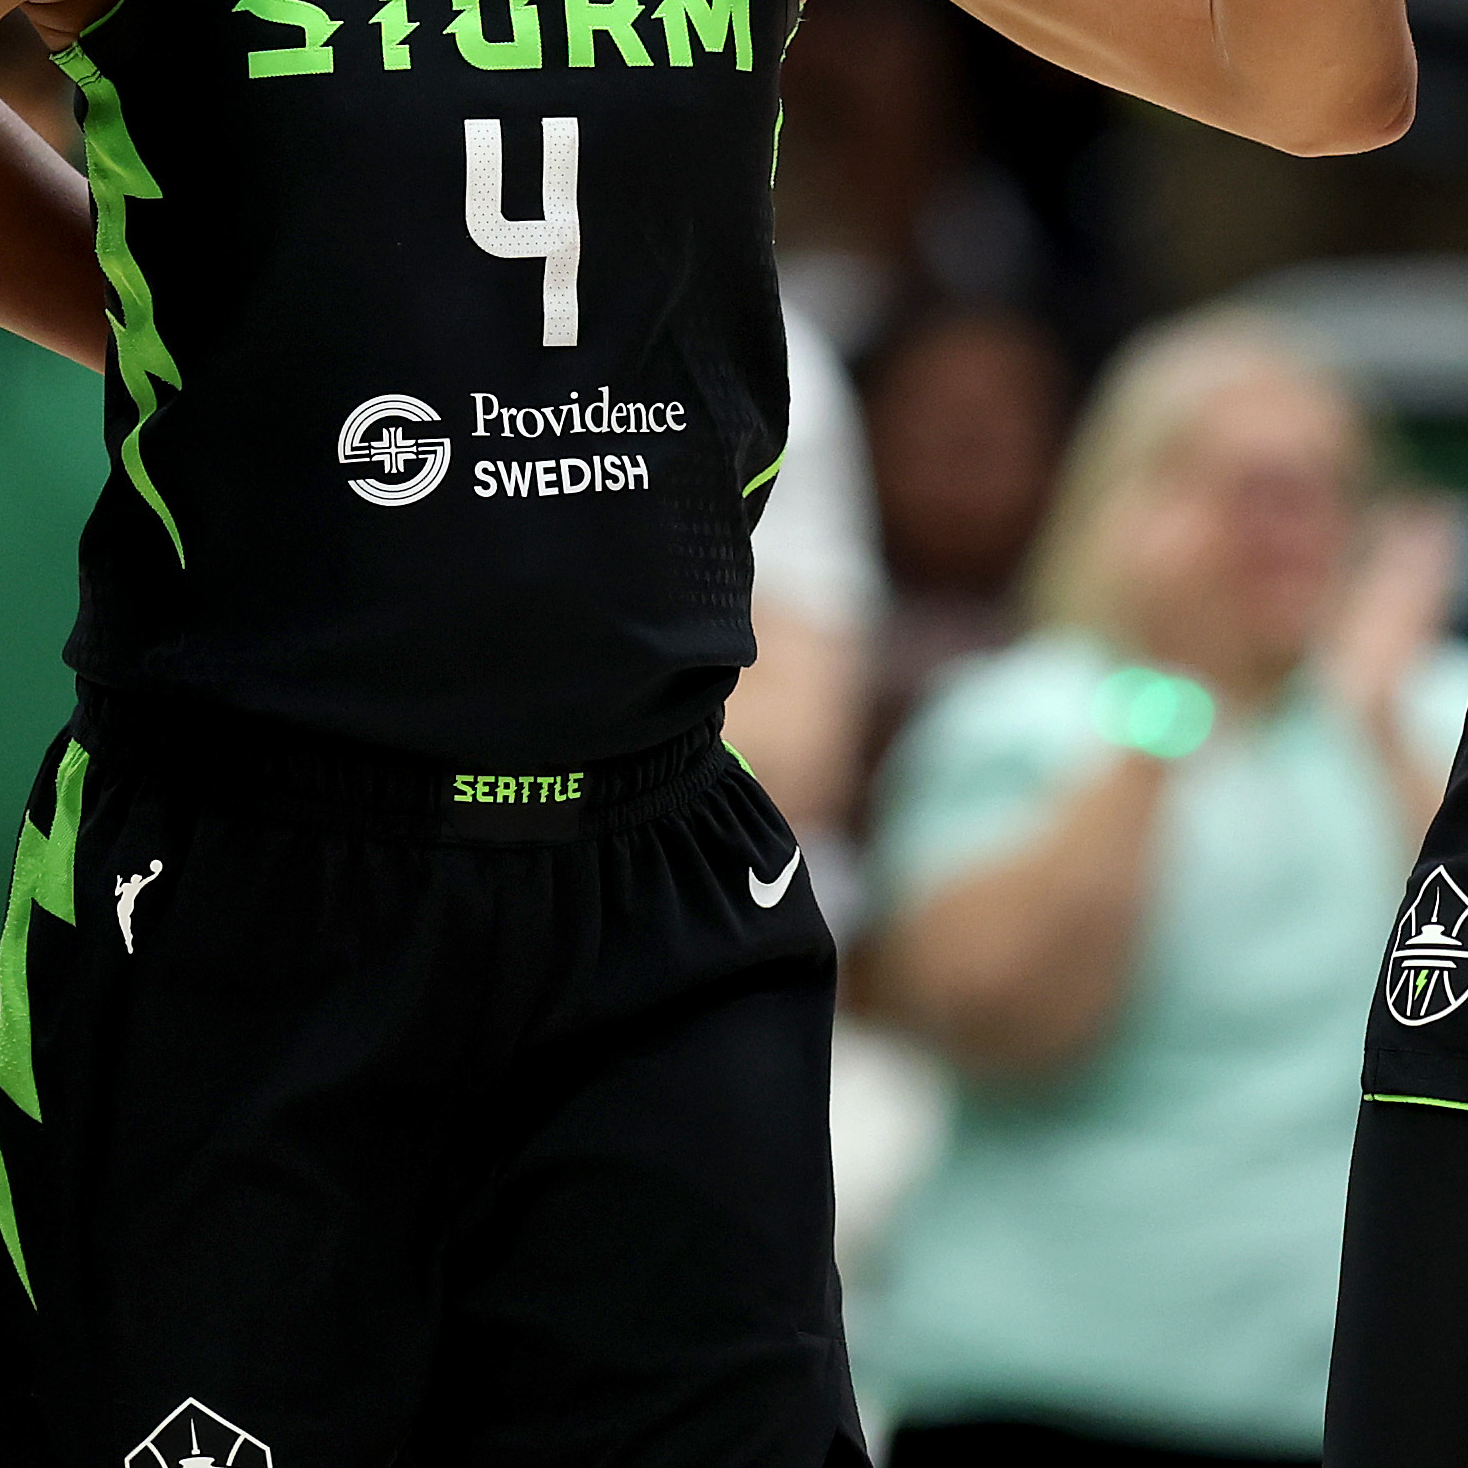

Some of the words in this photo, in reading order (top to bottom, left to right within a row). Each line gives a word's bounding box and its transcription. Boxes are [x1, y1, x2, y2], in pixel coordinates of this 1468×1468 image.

[463, 116, 581, 348] 4
[469, 385, 688, 439] Providence
[472, 453, 650, 499] SWEDISH
[452, 772, 585, 804] SEATTLE
